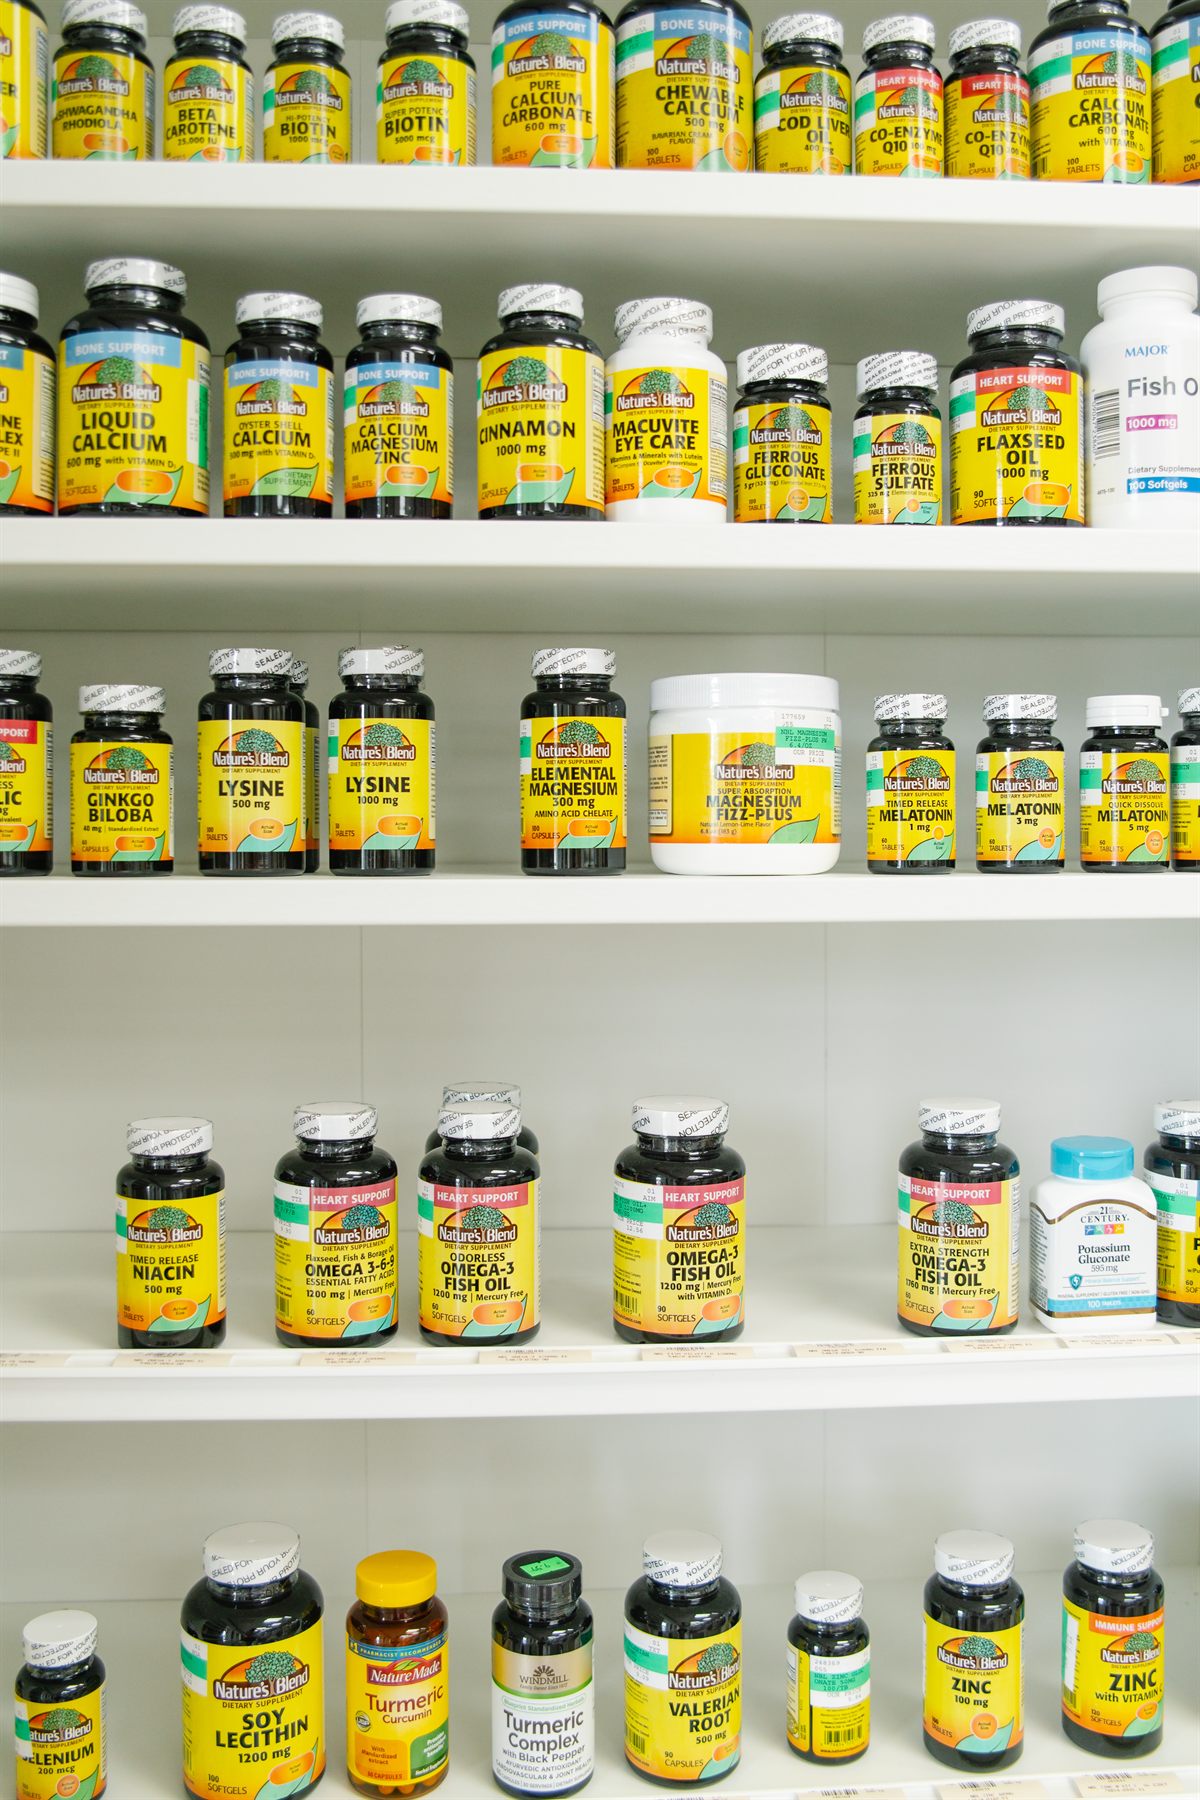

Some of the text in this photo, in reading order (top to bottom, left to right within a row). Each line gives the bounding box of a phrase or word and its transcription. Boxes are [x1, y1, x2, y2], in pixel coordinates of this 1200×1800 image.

[508, 19, 586, 37] BONE SUPPORT
[1075, 38, 1146, 56] BONE SUPPORT
[529, 81, 561, 91] PURE
[972, 82, 1002, 91] HEART
[511, 92, 582, 109] CALCIUM
[656, 85, 744, 111] CHEWABLE
[178, 108, 217, 121] BETA
[503, 107, 592, 127] CARBONATE
[664, 101, 739, 123] CALCIUM
[166, 123, 236, 140] CAROTENE
[280, 122, 336, 139] BIOTIN
[385, 117, 449, 137] BIOTIN
[525, 122, 566, 133] 600 mg
[777, 116, 850, 136] COD LIVER
[870, 127, 943, 145] CO-ENZYME
[882, 141, 907, 153] Q10
[979, 145, 1004, 156] Q10
[1066, 164, 1100, 175] TABLETS
[75, 343, 166, 356] BONE SUPPORT
[1124, 345, 1168, 358] MAJOR
[358, 369, 430, 380] BONE SUPPORT
[979, 375, 1062, 388] HEART SUPPORT
[1127, 376, 1176, 398] Fish
[82, 412, 155, 431] LIQUID
[239, 420, 303, 430] OYSTER SHELL
[613, 419, 699, 438] MACUVITE
[359, 423, 428, 438] CALCIUM
[480, 420, 576, 444] CINNAMON
[73, 433, 167, 452] CALCIUM
[233, 430, 311, 447] CALCIUM
[351, 438, 438, 453] MAGNESIUM
[615, 435, 696, 452] EYE CARE
[977, 435, 1065, 452] FLAXSEED
[496, 443, 546, 456] 1000 mg
[375, 452, 411, 464] ZINC
[754, 451, 818, 465] FERROUS
[1006, 451, 1039, 465] OIL
[746, 465, 825, 481] GLUCONATE
[872, 464, 936, 477] FERROUS
[875, 477, 934, 491] SULFATE
[974, 490, 984, 498] 90
[84, 770, 158, 783] Nature's Blend
[531, 767, 616, 781] ELEMENTAL
[218, 780, 284, 797] LYSINE
[346, 777, 410, 793] LYSINE
[529, 782, 618, 796] MAGNESIUM
[885, 778, 949, 790] Nature's Blend
[992, 780, 1057, 791] Nature's Blend
[1103, 781, 1166, 793] Nature's Blend
[88, 793, 154, 807] GINKGO
[232, 800, 270, 810] 500 mg
[357, 796, 398, 806] 1000 mg
[706, 796, 802, 808] MAGNESIUM
[887, 800, 948, 808] TIMED RELEASE
[89, 809, 153, 822] BILOBA
[582, 809, 613, 817] CHELATE
[717, 808, 793, 821] FIZZ-PLUS
[880, 810, 952, 821] MELATONIN
[988, 803, 1061, 816] MELATONIN
[1098, 810, 1168, 822] MELATONIN
[313, 1188, 391, 1205] HEART SUPPORT
[437, 1191, 519, 1202] HEART SUPPORT
[666, 1186, 740, 1202] HEART SUPPORT
[911, 1185, 991, 1198] HEART SUPPORT
[1080, 1214, 1127, 1223] CENTURY
[305, 1253, 341, 1262] Flaxseed,
[342, 1253, 358, 1261] Fish
[367, 1248, 388, 1261] Borage
[666, 1245, 738, 1266] OMEGA-3
[910, 1242, 989, 1257] EXTRA STRENGTH
[1078, 1243, 1131, 1254] Potassium
[130, 1254, 199, 1264] TIMED RELEASE
[450, 1252, 505, 1262] ODORLESS
[912, 1252, 986, 1272] OMEGA-3
[1078, 1253, 1130, 1265] Gluconate
[133, 1264, 195, 1280] NIACIN
[305, 1257, 395, 1277] OMEGA 3-6-9
[441, 1262, 514, 1276] OMEGA-3
[672, 1261, 736, 1282] FISH OIL
[444, 1276, 511, 1291] FISH OIL
[915, 1268, 982, 1286] FISH OIL
[145, 1285, 183, 1295] 500 mg
[678, 1290, 725, 1301] with VITAMIN
[658, 1305, 666, 1313] 90
[658, 1314, 696, 1323] SOFTGELS
[1095, 1620, 1135, 1632] IMMUNE
[360, 1639, 441, 1657] PHARMACIST RECOMMENDED
[370, 1660, 441, 1683] Nature Made
[519, 1674, 568, 1685] WINDMILL
[951, 1677, 992, 1695] ZINC
[1109, 1669, 1157, 1692] ZINC
[365, 1686, 444, 1713] Turmeric
[669, 1685, 740, 1717] VALERIAN
[954, 1695, 989, 1709] 100 mg
[242, 1707, 285, 1730] SOY
[383, 1709, 432, 1724] Curcumin
[504, 1710, 584, 1734] Turmeric
[690, 1709, 731, 1733] ROOT
[216, 1715, 309, 1748] LECITHIN
[696, 1731, 727, 1744] 500 mg
[508, 1732, 580, 1754] Complex
[238, 1746, 291, 1763] 1200 mg
[502, 1745, 585, 1763] with Black Pepper
[665, 1759, 704, 1768] CAPSULES
[208, 1783, 247, 1794] SOFTGELS
